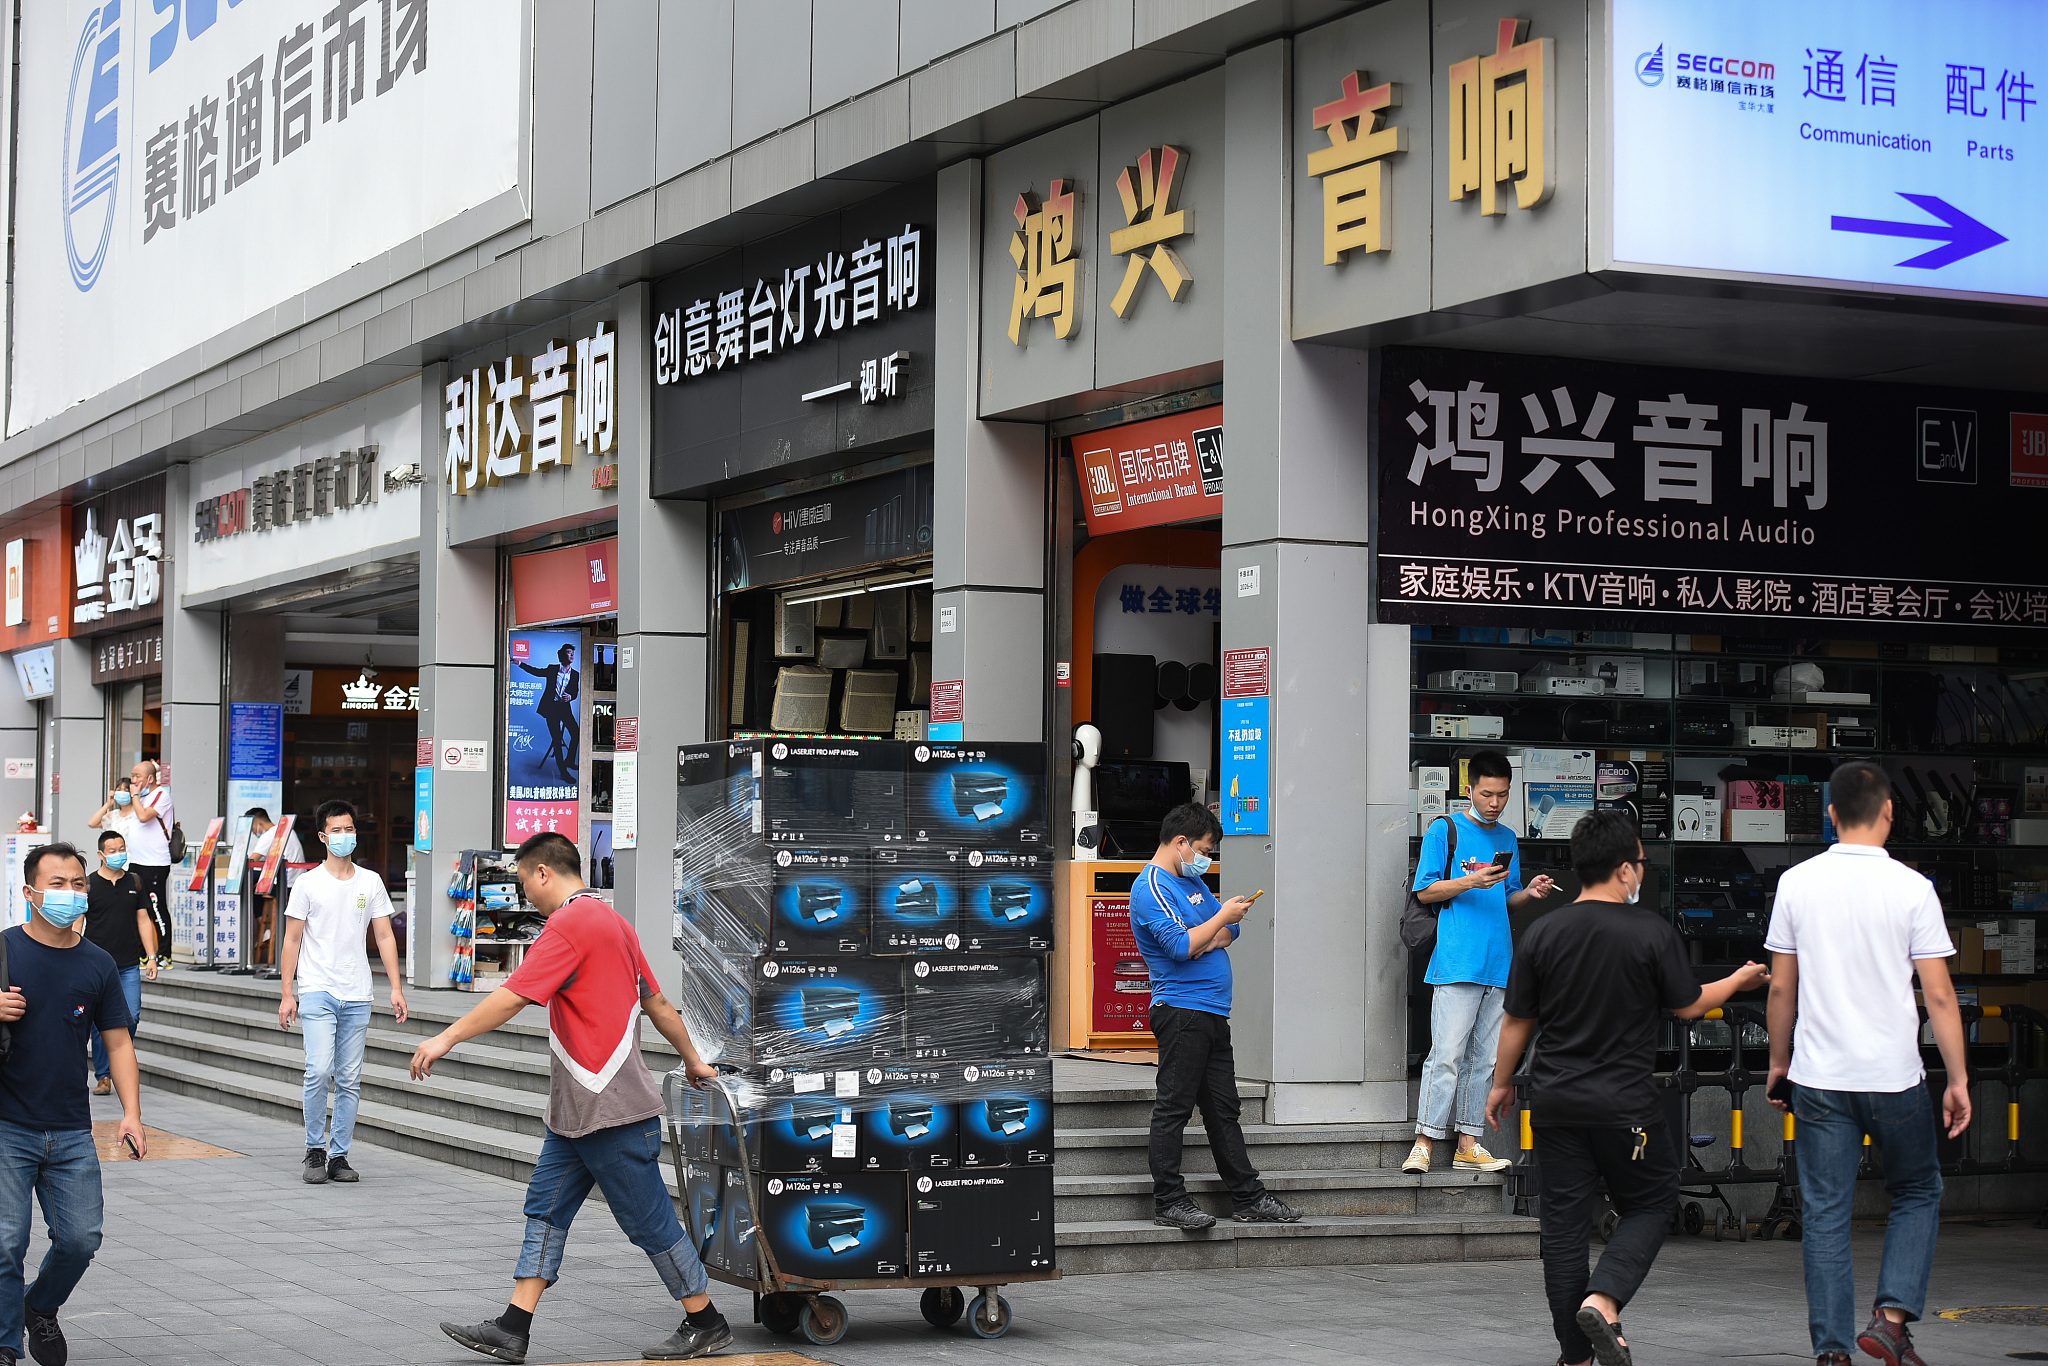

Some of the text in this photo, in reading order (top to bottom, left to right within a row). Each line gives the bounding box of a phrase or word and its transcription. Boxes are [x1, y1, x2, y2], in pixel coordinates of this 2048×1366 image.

[1677, 53, 1775, 79] SEGCOM
[1677, 75, 1775, 98] 赛格通信市场
[1802, 47, 2038, 123] 通信 配件
[1738, 101, 1775, 114] 宝华大厦
[144, 0, 428, 245] 赛格通信市场
[1800, 122, 2014, 161] Communication Parts
[655, 223, 921, 385] 创意舞台灯光音响
[859, 351, 900, 404] 视听
[446, 322, 616, 494] 利达音响
[1406, 379, 1829, 512] 鸿兴音响
[1118, 439, 1191, 487] 国际品牌
[1089, 464, 1115, 495] JBL
[1126, 481, 1198, 506] International Brand
[1410, 501, 1816, 545] HongXing Professional Audio
[783, 536, 819, 555] 专注声音品质
[107, 513, 162, 613] 金冠
[590, 559, 606, 583] JBL
[1228, 728, 1262, 742] 不乱扔垃圾
[932, 750, 956, 758] M126a
[516, 807, 572, 816] 我们有更专业的
[515, 818, 558, 832] 试音室
[794, 855, 818, 863] M126a
[196, 901, 236, 911] 移靓号
[981, 1069, 1005, 1077] M126a
